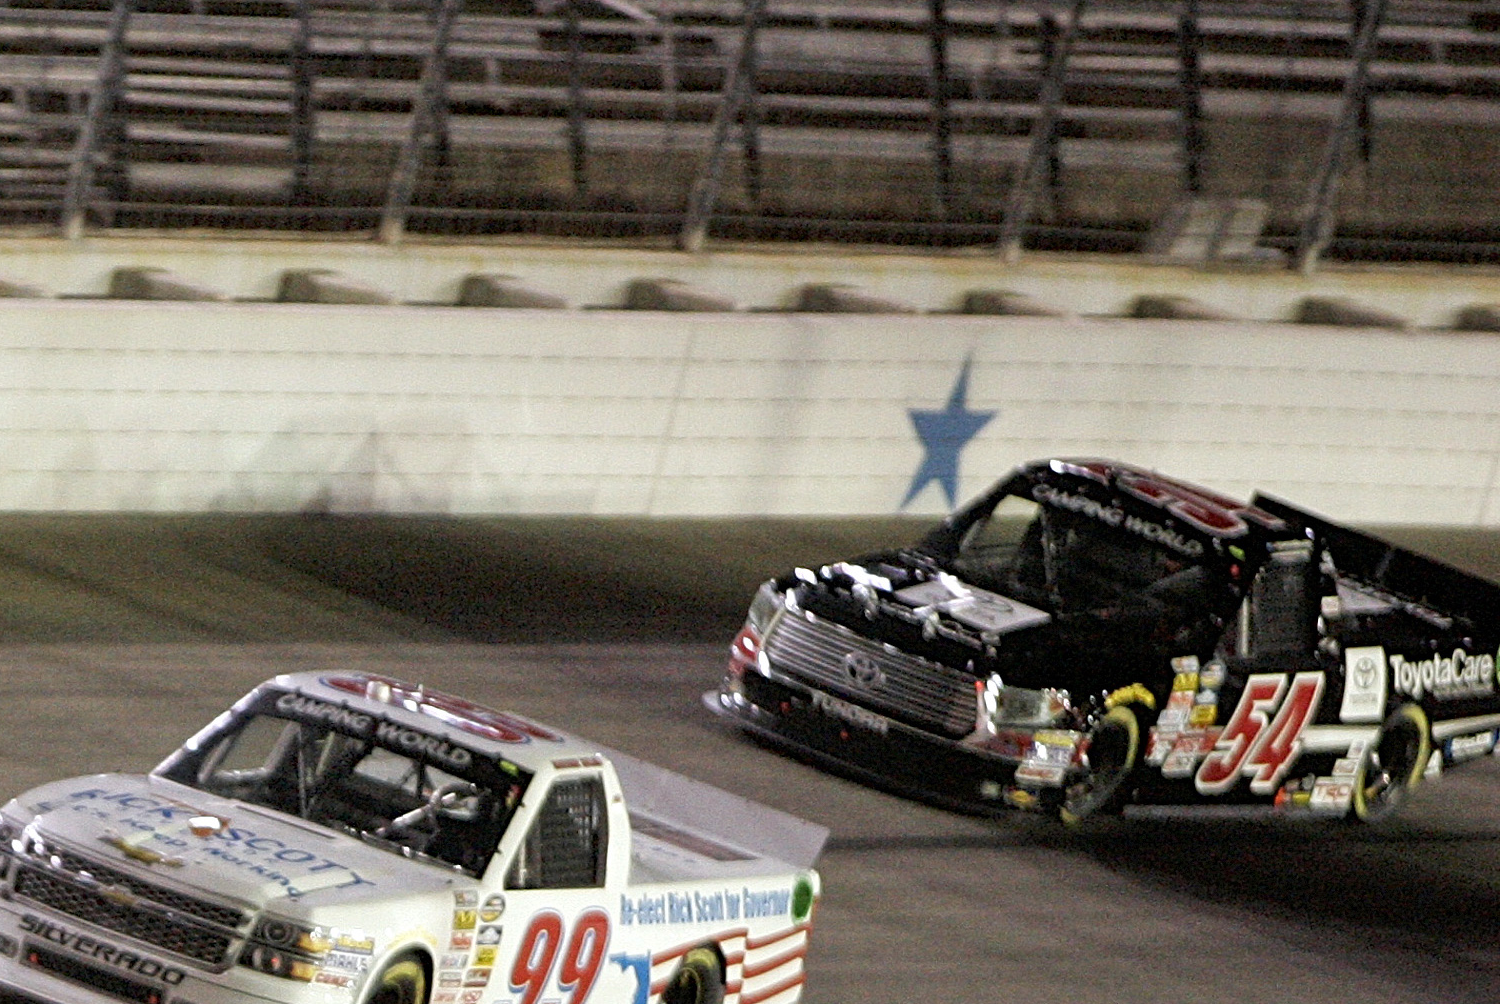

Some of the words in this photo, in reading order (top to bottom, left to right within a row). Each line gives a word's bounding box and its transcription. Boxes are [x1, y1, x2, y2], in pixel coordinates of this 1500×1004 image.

[1032, 483, 1125, 526] CAMPING
[1124, 514, 1203, 556] WORLD
[1390, 648, 1493, 700] ToyotaCare
[276, 693, 373, 734] CAMPING
[375, 720, 473, 768] WORLD
[1195, 671, 1326, 795] 54
[214, 827, 377, 889] SCOTT
[17, 912, 187, 985] SILVERADO
